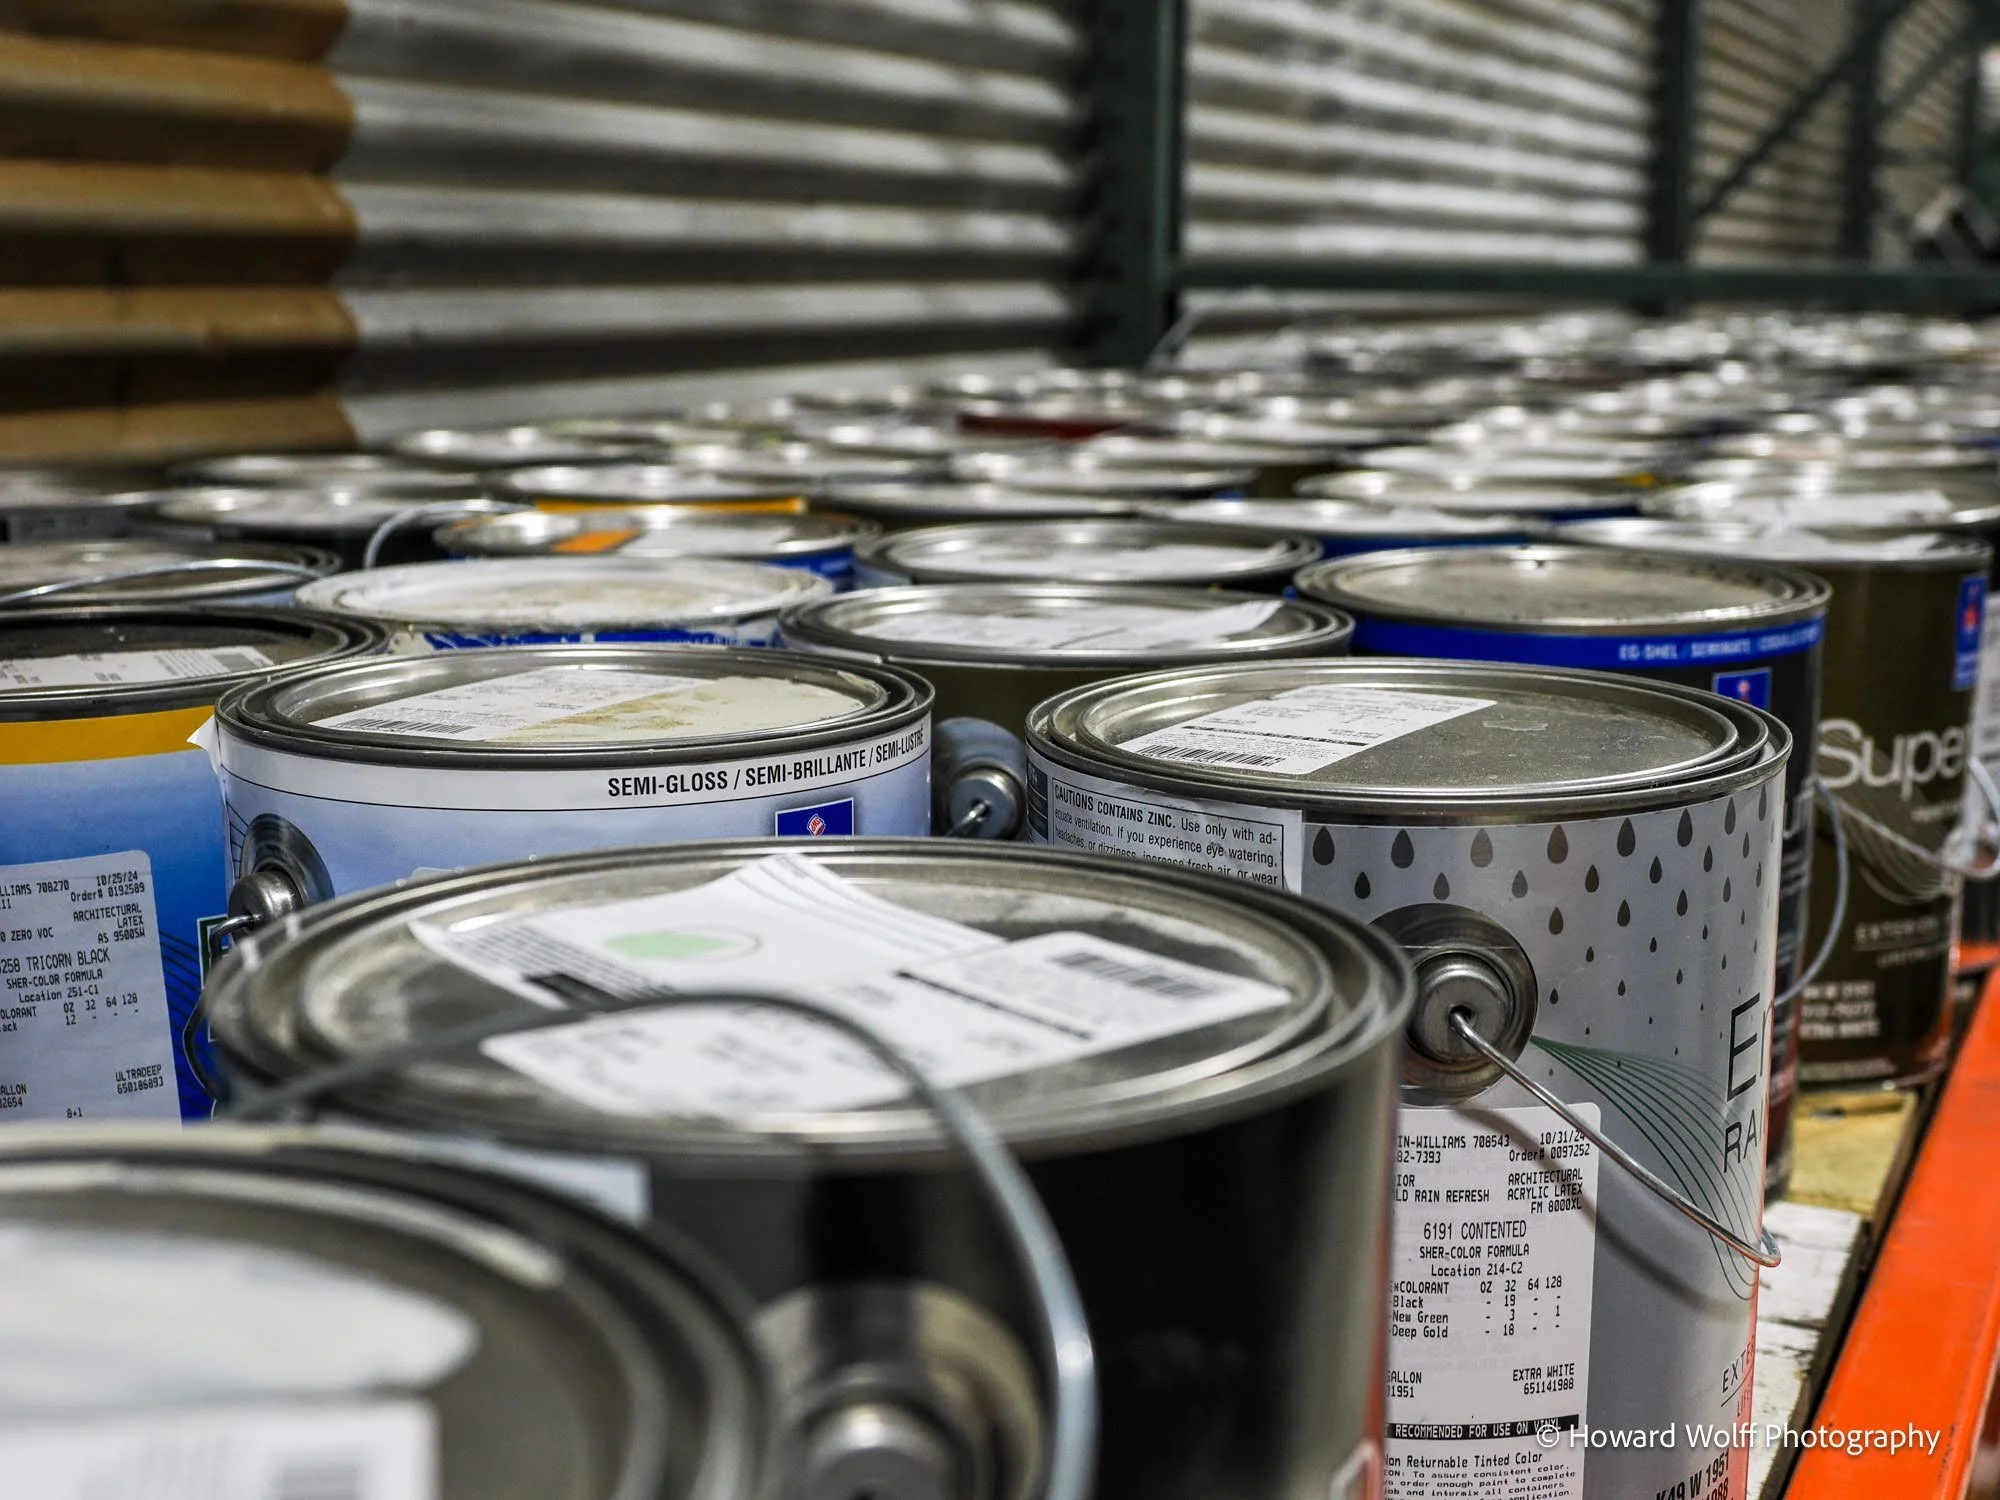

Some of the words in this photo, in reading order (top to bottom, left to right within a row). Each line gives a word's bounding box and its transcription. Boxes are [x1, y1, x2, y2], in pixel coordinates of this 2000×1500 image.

[608, 769, 729, 798] SEMI-GLOSS
[745, 748, 867, 788] SEMI-BRILLANTE
[1054, 784, 1094, 811] CAUTIONS
[1097, 801, 1143, 823] CONTAINS
[1148, 811, 1176, 829] ZINC.
[1181, 818, 1200, 832] Use
[1205, 824, 1227, 840] only
[1232, 827, 1254, 842] with
[1259, 830, 1277, 845] ad-
[1074, 816, 1113, 836] ventilation.
[1118, 825, 1124, 839] If
[1126, 831, 1144, 846] you
[1148, 834, 1202, 853] experience
[1206, 844, 1224, 858] eye
[1228, 847, 1278, 868] watering,
[36, 880, 70, 894] 708270
[96, 870, 138, 887] 10/25/24
[1251, 872, 1278, 886] wear
[70, 889, 103, 903] Order#
[73, 902, 142, 922] ARCHITECTURAL
[117, 915, 144, 929] LATEX
[10, 930, 33, 942] ZERO
[37, 927, 54, 939] VOC
[97, 933, 109, 944] AS
[0, 958, 21, 974] 258
[26, 952, 73, 971] TRICORN
[77, 947, 111, 966] BLACK
[6, 973, 61, 990] SHER-COLOR
[65, 968, 103, 983] FORMULA
[18, 990, 62, 1003] Location
[67, 984, 99, 998] 251-C1
[85, 1000, 96, 1011] 32
[106, 996, 117, 1008] 64
[122, 993, 138, 1005] 128
[65, 1014, 77, 1026] 12
[115, 1063, 162, 1082] ULTRADEEP
[1397, 1135, 1467, 1149] IN-WILLIAMS
[1473, 1134, 1510, 1148] 708543
[1540, 1130, 1586, 1145] 10/31/24
[1509, 1147, 1545, 1162] Order#
[1550, 1144, 1590, 1158] 0097252
[1508, 1168, 1583, 1185] ARCHITECTURAL
[1414, 1190, 1440, 1203] RAIN
[1446, 1189, 1490, 1203] REFRESH
[1507, 1186, 1549, 1201] ACRYLIC
[1554, 1183, 1583, 1197] LATEX
[1531, 1201, 1543, 1214] FM
[1548, 1198, 1582, 1213] 8000XL
[1423, 1222, 1452, 1240] 6191
[1461, 1220, 1527, 1240] CONTENTED
[1419, 1246, 1482, 1259] SHER-COLOR
[1487, 1243, 1530, 1258] FORMULA
[1431, 1264, 1481, 1277] Location
[1486, 1262, 1523, 1276] 214-C2
[1480, 1281, 1492, 1294] OZ
[1504, 1280, 1516, 1292] 32
[1527, 1278, 1539, 1291] 64
[1545, 1275, 1562, 1289] 128
[1393, 1295, 1424, 1308] Black
[1504, 1295, 1516, 1307] 19
[1392, 1310, 1411, 1322] New
[1417, 1311, 1448, 1323] Green
[1509, 1309, 1516, 1321] 3
[1555, 1305, 1561, 1317] 1
[1392, 1324, 1417, 1340] Deep
[1423, 1325, 1448, 1338] Gold
[1503, 1324, 1515, 1336] 18
[1512, 1367, 1542, 1382] EXTRA
[1547, 1363, 1575, 1377] WHITE
[1523, 1378, 1574, 1395] 651141988
[1395, 1424, 1463, 1438] RECOMMENDED
[1469, 1424, 1487, 1437] FOR
[1493, 1422, 1511, 1436] USE
[1516, 1421, 1529, 1434] ON
[1407, 1454, 1468, 1468] Returnable
[1474, 1453, 1510, 1467] Tinted
[1515, 1451, 1543, 1465] Color
[1437, 1480, 1474, 1489] enough
[1479, 1478, 1508, 1488] paint
[1515, 1476, 1527, 1484] to
[1531, 1471, 1576, 1484] complete
[1474, 1467, 1531, 1478] consistent
[1690, 1470, 1703, 1499] W
[1705, 1448, 1730, 1487] 1951
[1406, 1488, 1424, 1496] and
[1431, 1488, 1479, 1497] intermix
[1485, 1487, 1502, 1496] all
[1508, 1482, 1564, 1494] containers
